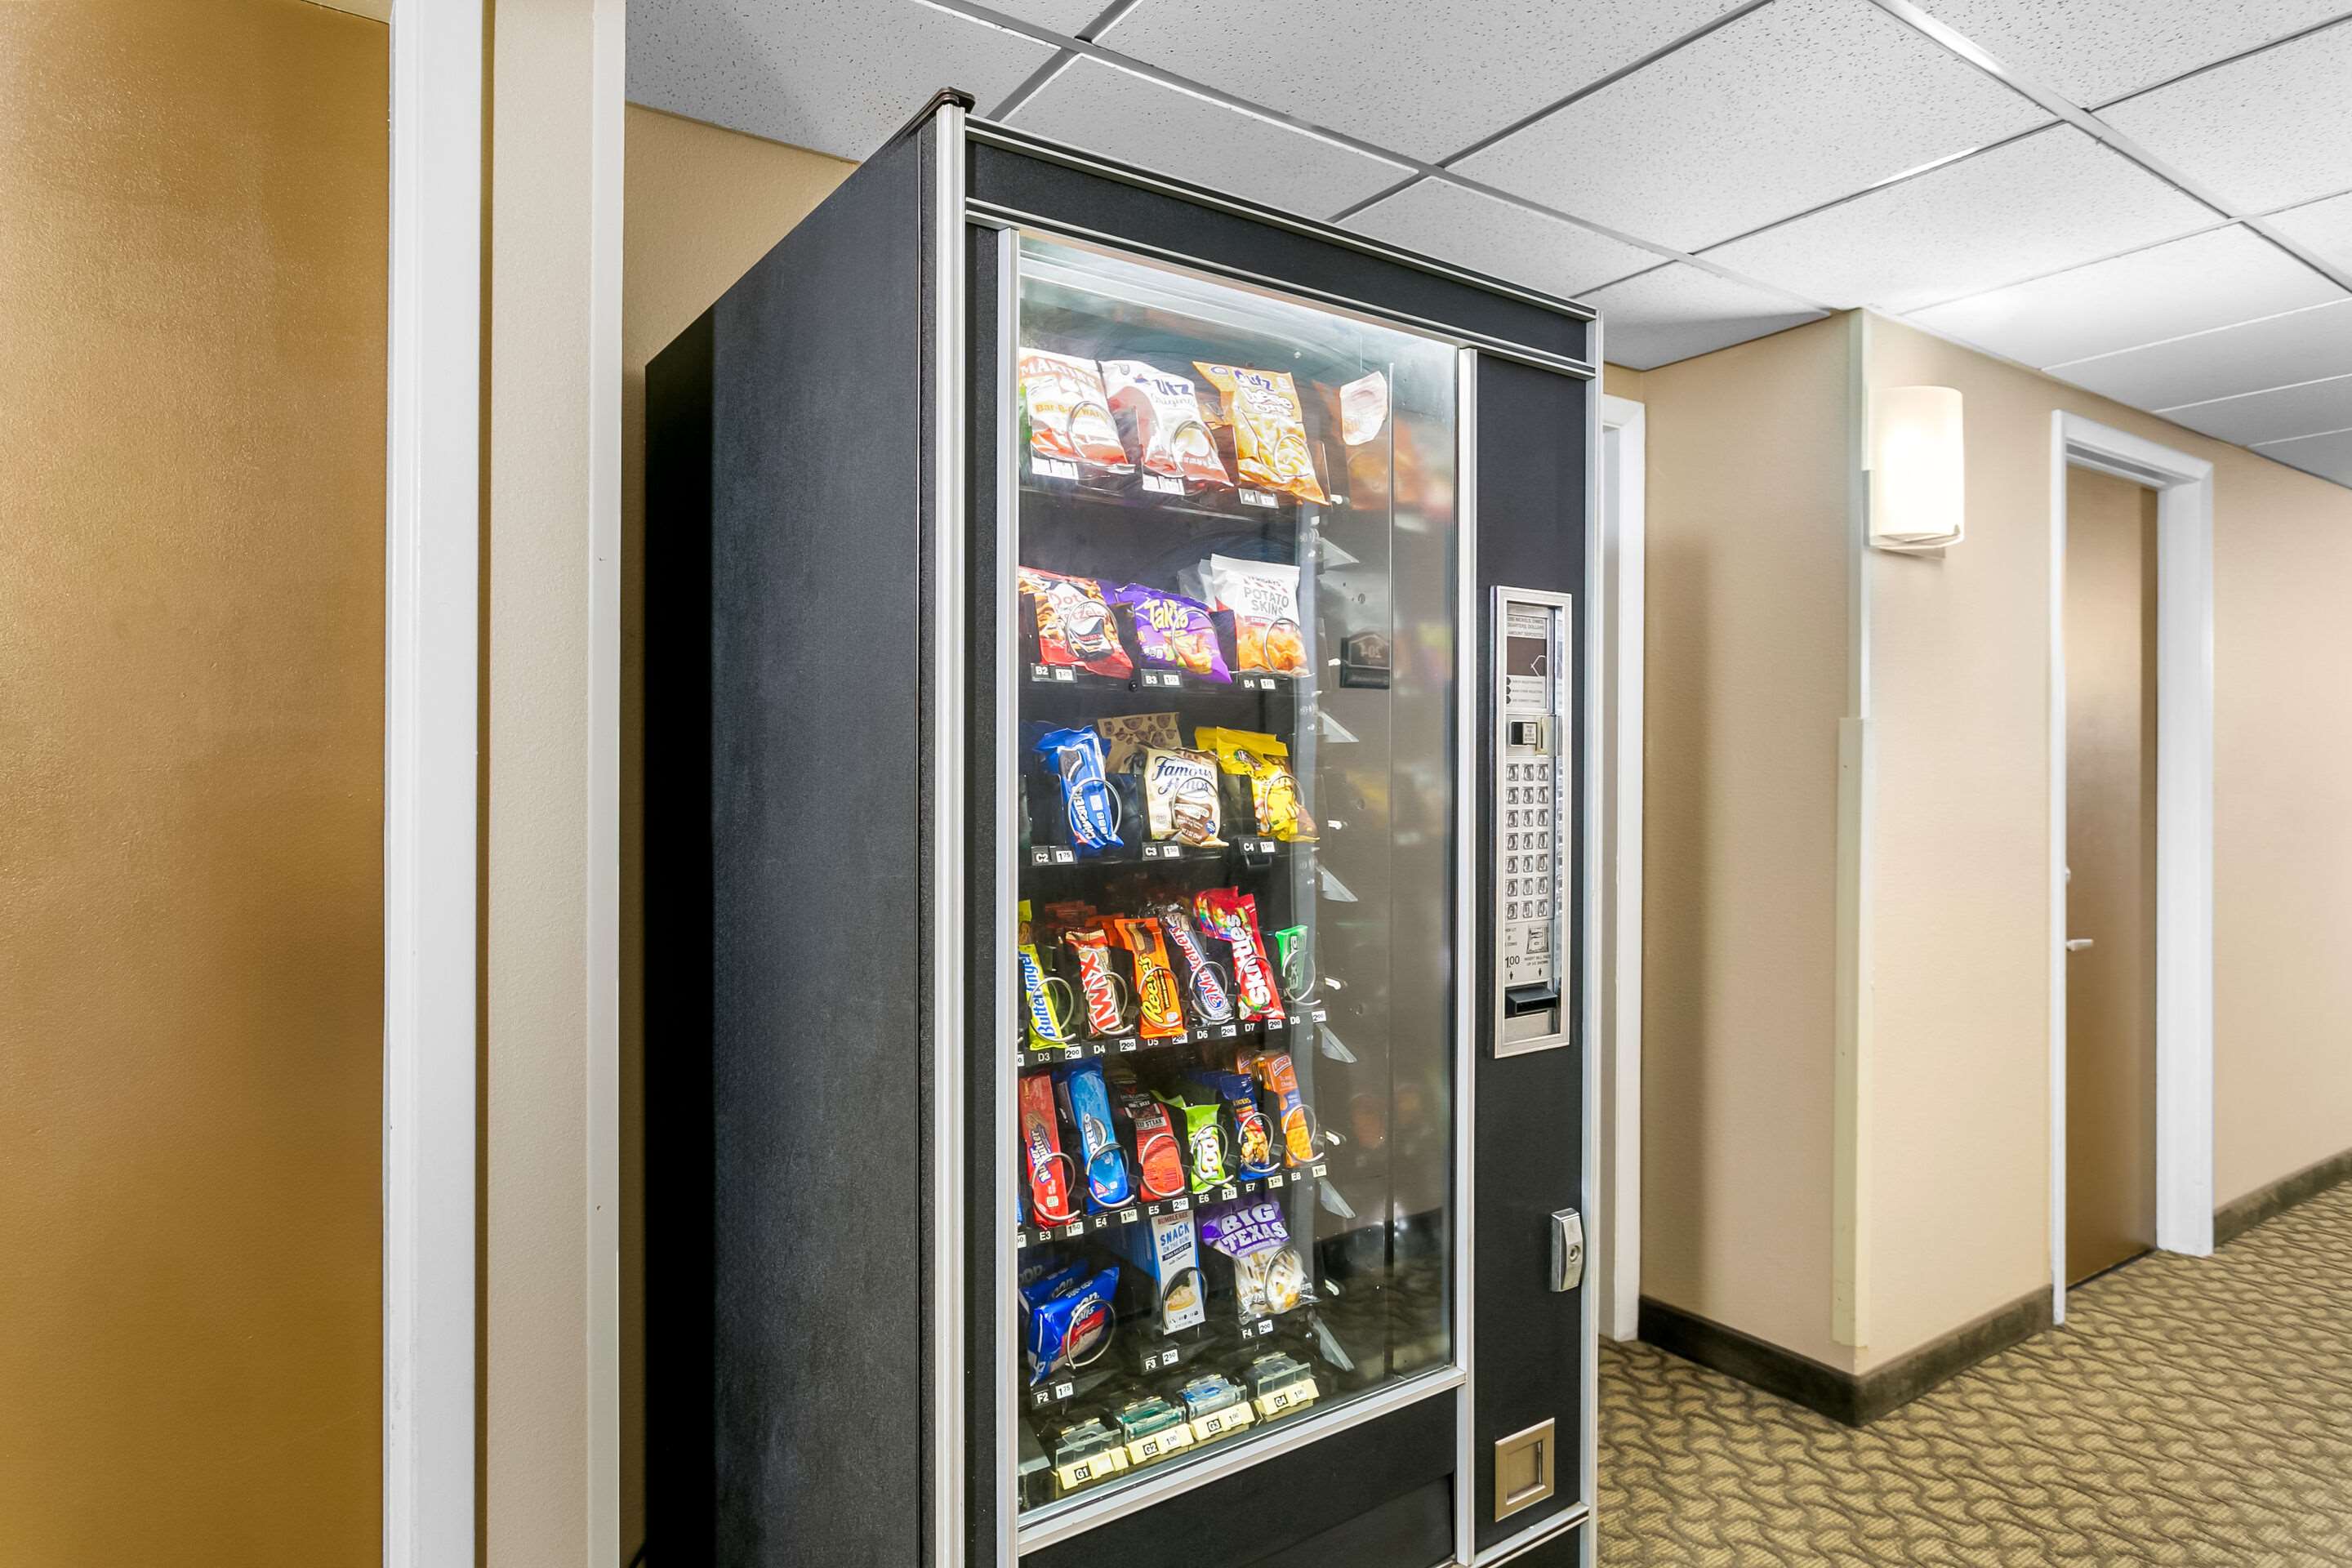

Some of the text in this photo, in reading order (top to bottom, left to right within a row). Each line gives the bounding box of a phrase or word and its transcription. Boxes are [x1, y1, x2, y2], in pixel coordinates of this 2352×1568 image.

[1244, 493, 1255, 504] A4
[1244, 586, 1290, 608] POTATO
[1252, 599, 1285, 616] SKINS
[1036, 666, 1049, 675] B2
[1145, 675, 1157, 684] B3
[1244, 679, 1254, 688] B4
[1152, 755, 1214, 782] Famous
[1145, 847, 1157, 856] C3
[1243, 843, 1254, 852] C4
[1036, 853, 1049, 863] C2
[1227, 914, 1272, 1005] Skittles
[1080, 951, 1120, 1035] TWIX
[1290, 1016, 1300, 1024] D8
[1245, 1023, 1255, 1031] D7
[1196, 1031, 1208, 1039] D6
[1094, 1041, 1134, 1054] D4 200
[1147, 1038, 1159, 1046] D5
[1038, 1053, 1050, 1062] D3
[1246, 1183, 1255, 1192] E7
[1199, 1194, 1209, 1203] E6
[1148, 1200, 1187, 1214] E5 250
[1096, 1211, 1135, 1227] E4 150
[1221, 1204, 1276, 1235] BIG
[1039, 1231, 1051, 1241] E3
[1160, 1222, 1190, 1246] SNACK
[1222, 1222, 1288, 1252] TEXAS
[1242, 1329, 1253, 1339] F4
[1146, 1352, 1176, 1370] F3 250
[1036, 1385, 1071, 1404] F2 175
[1275, 1396, 1287, 1406] G4
[1207, 1420, 1220, 1431] G3
[1144, 1442, 1157, 1454] G2
[1076, 1468, 1089, 1480] G1
